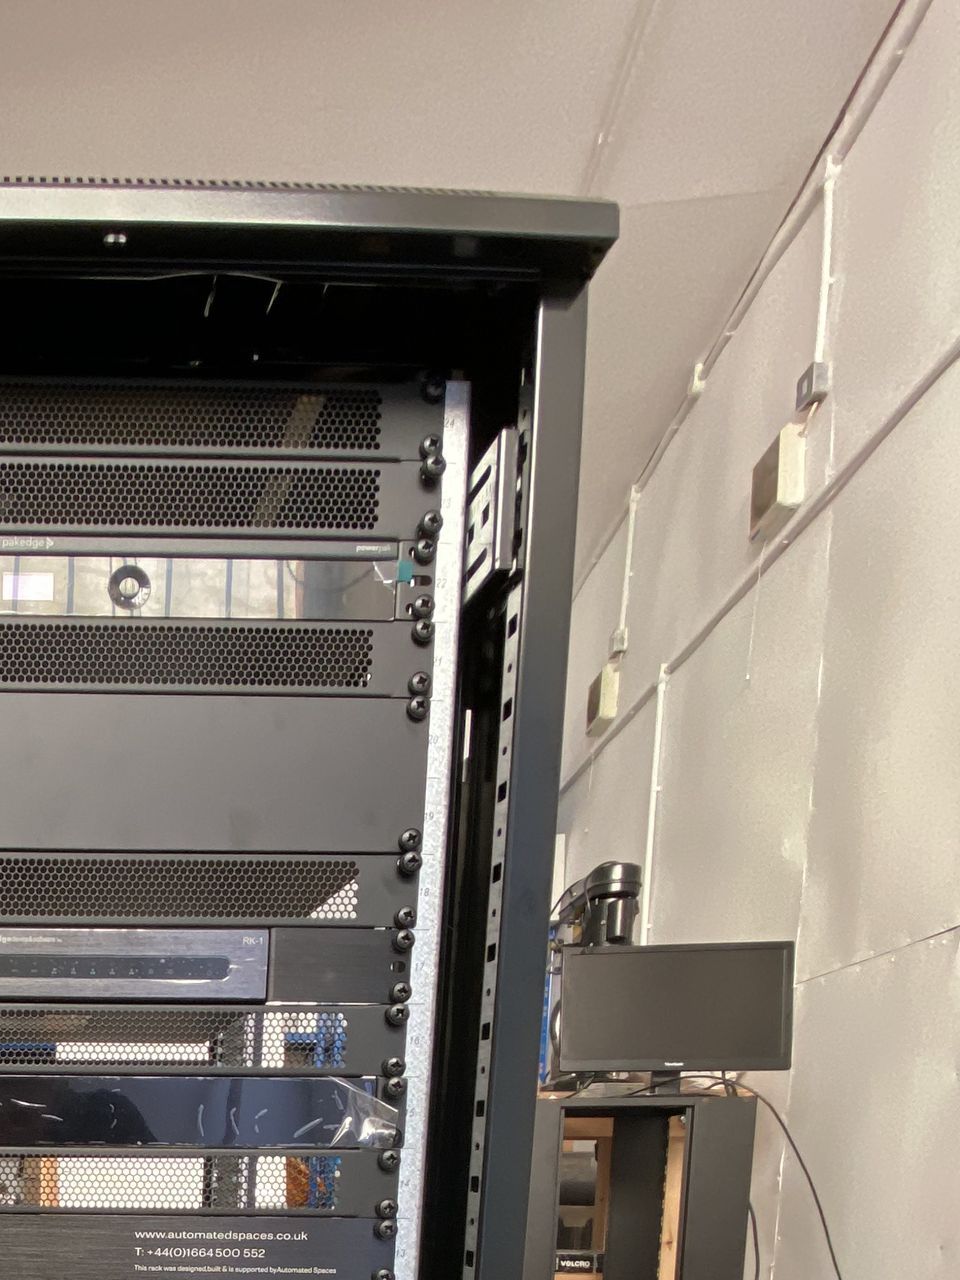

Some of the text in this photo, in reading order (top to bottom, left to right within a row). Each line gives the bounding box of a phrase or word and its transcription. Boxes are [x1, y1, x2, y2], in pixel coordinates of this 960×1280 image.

[2, 536, 45, 549] pakedge
[242, 936, 264, 945] RK-1
[134, 1230, 308, 1242] www.automatedspaces.co.uk
[134, 1247, 145, 1257] T:
[243, 1248, 266, 1258] 552
[134, 1264, 147, 1272] This
[313, 1267, 337, 1275] Spaces
